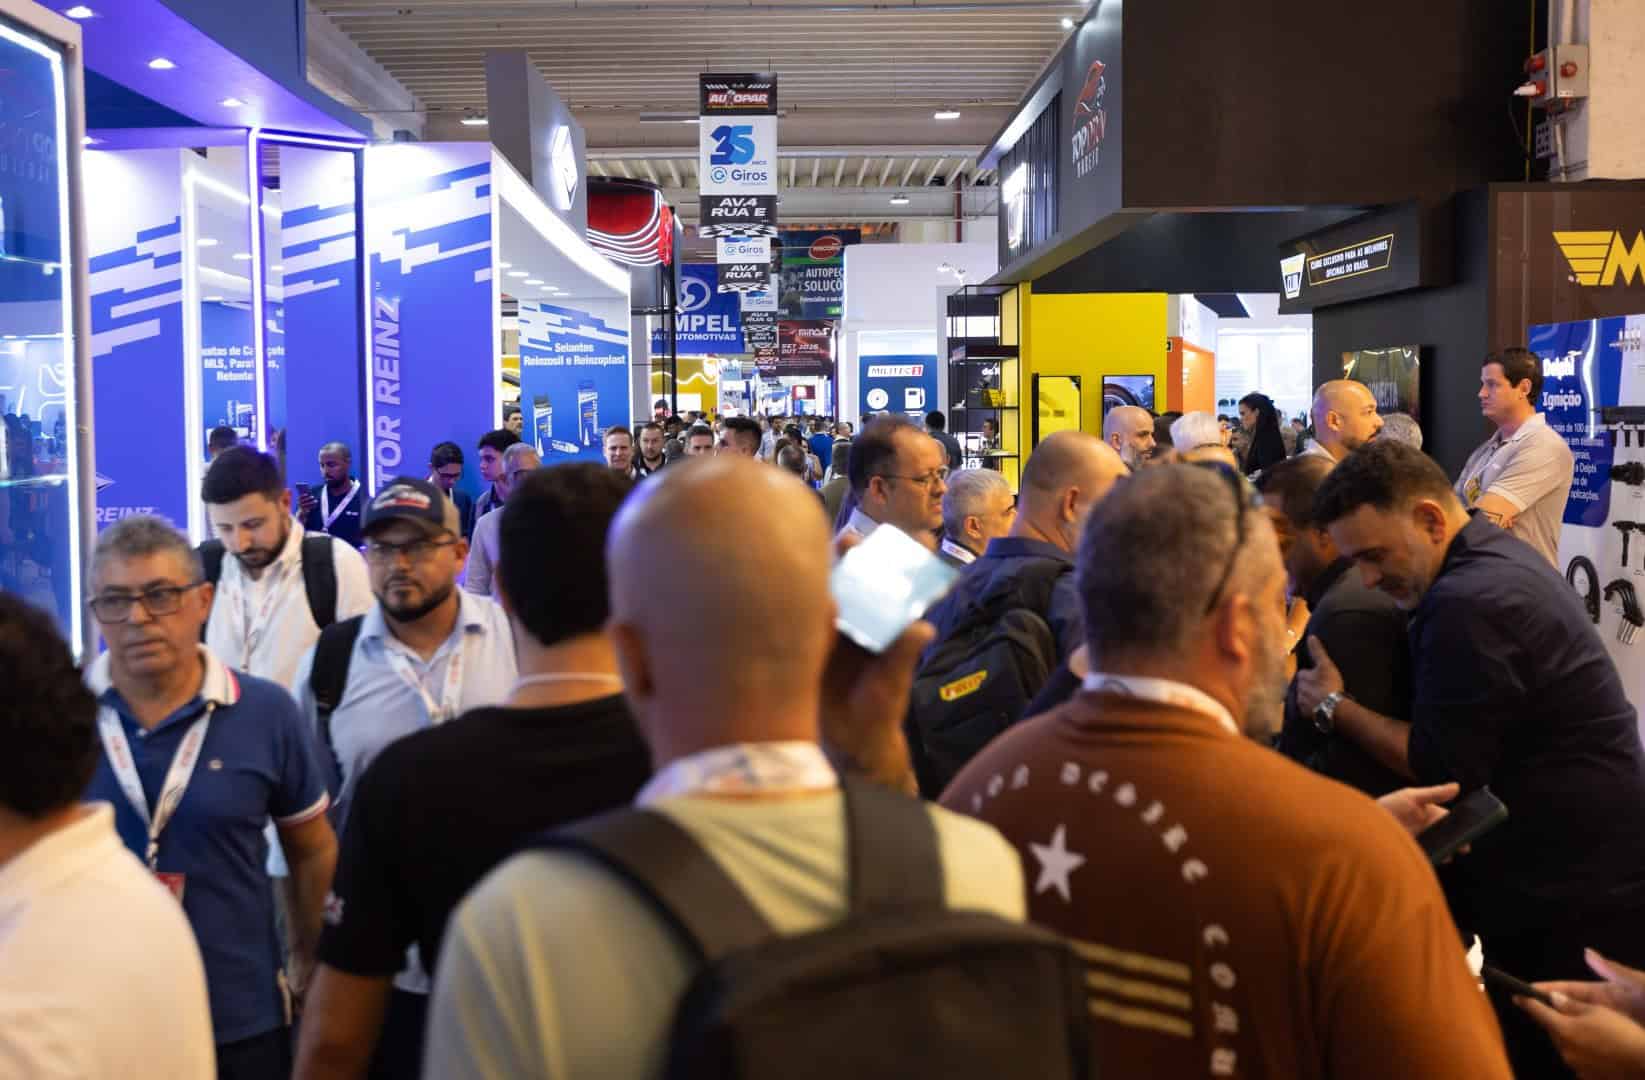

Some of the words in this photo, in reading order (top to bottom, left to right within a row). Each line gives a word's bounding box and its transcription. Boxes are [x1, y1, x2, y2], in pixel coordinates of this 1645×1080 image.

[731, 169, 768, 181] Giros
[711, 207, 749, 217] RUA
[754, 207, 767, 217] E
[738, 246, 764, 254] Giros
[229, 346, 241, 356] de
[375, 296, 400, 405] REINZ
[1542, 389, 1582, 411] Ignição
[1574, 423, 1585, 432] 100
